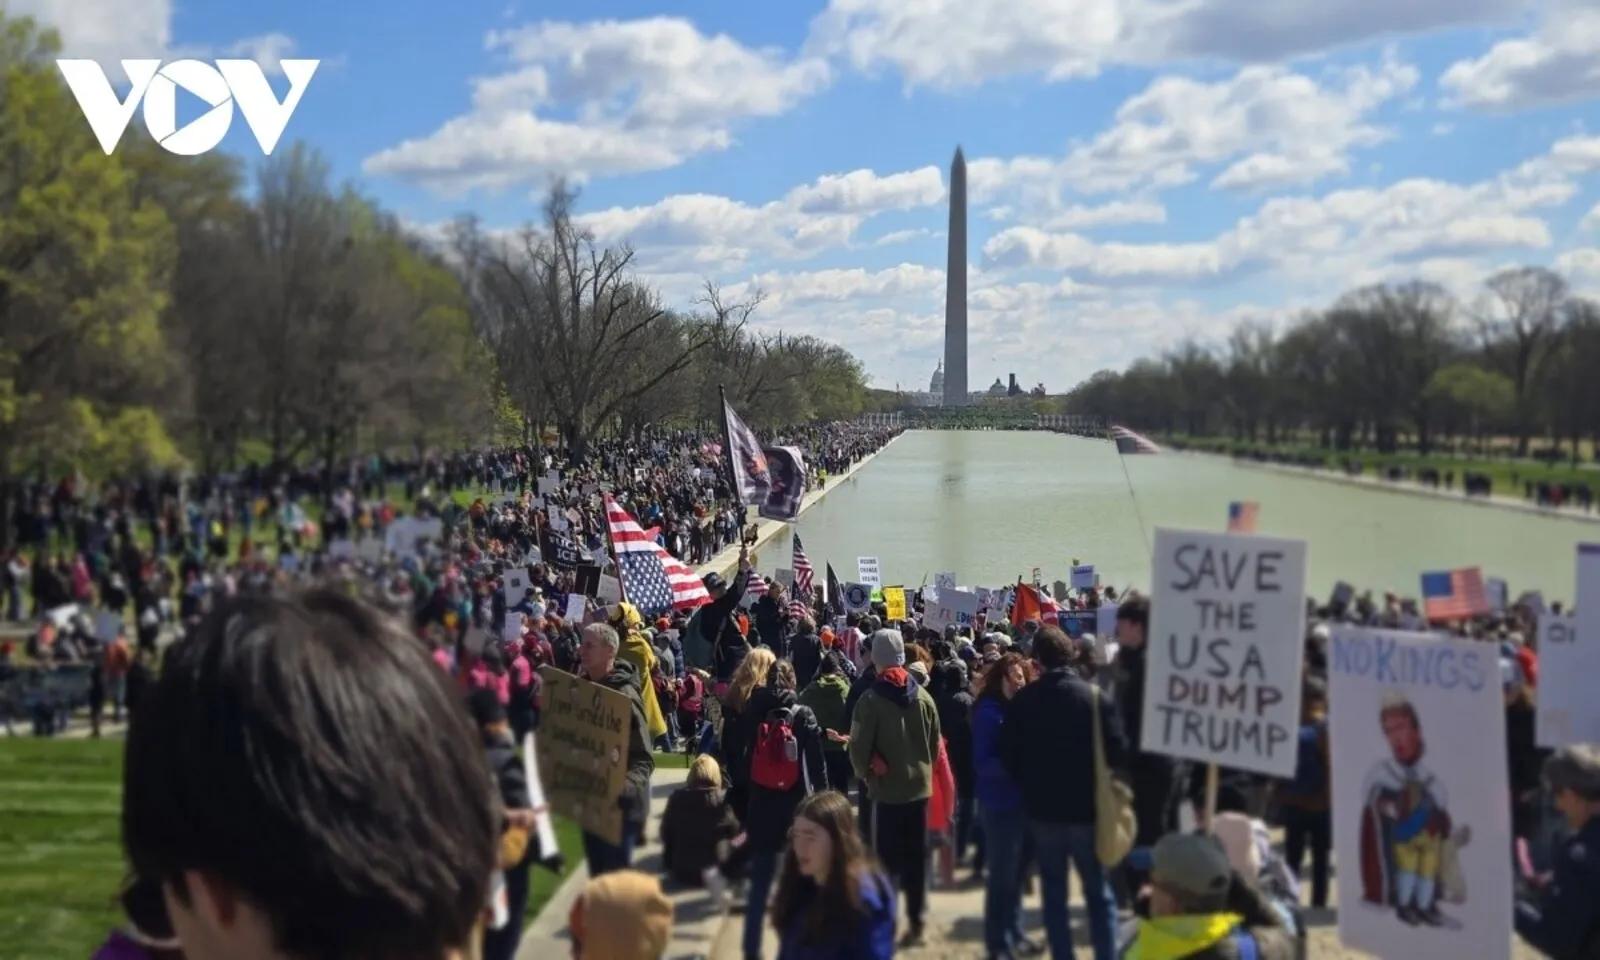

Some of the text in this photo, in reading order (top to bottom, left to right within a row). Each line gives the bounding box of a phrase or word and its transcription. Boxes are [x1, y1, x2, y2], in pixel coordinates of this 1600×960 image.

[556, 547, 577, 563] ICE
[1171, 544, 1284, 592] SAVE
[1194, 599, 1257, 632] THE
[1169, 633, 1266, 681] USA
[1375, 636, 1486, 692] KINGS
[1168, 673, 1283, 717] DUMP
[1156, 703, 1290, 758] TRUMP
